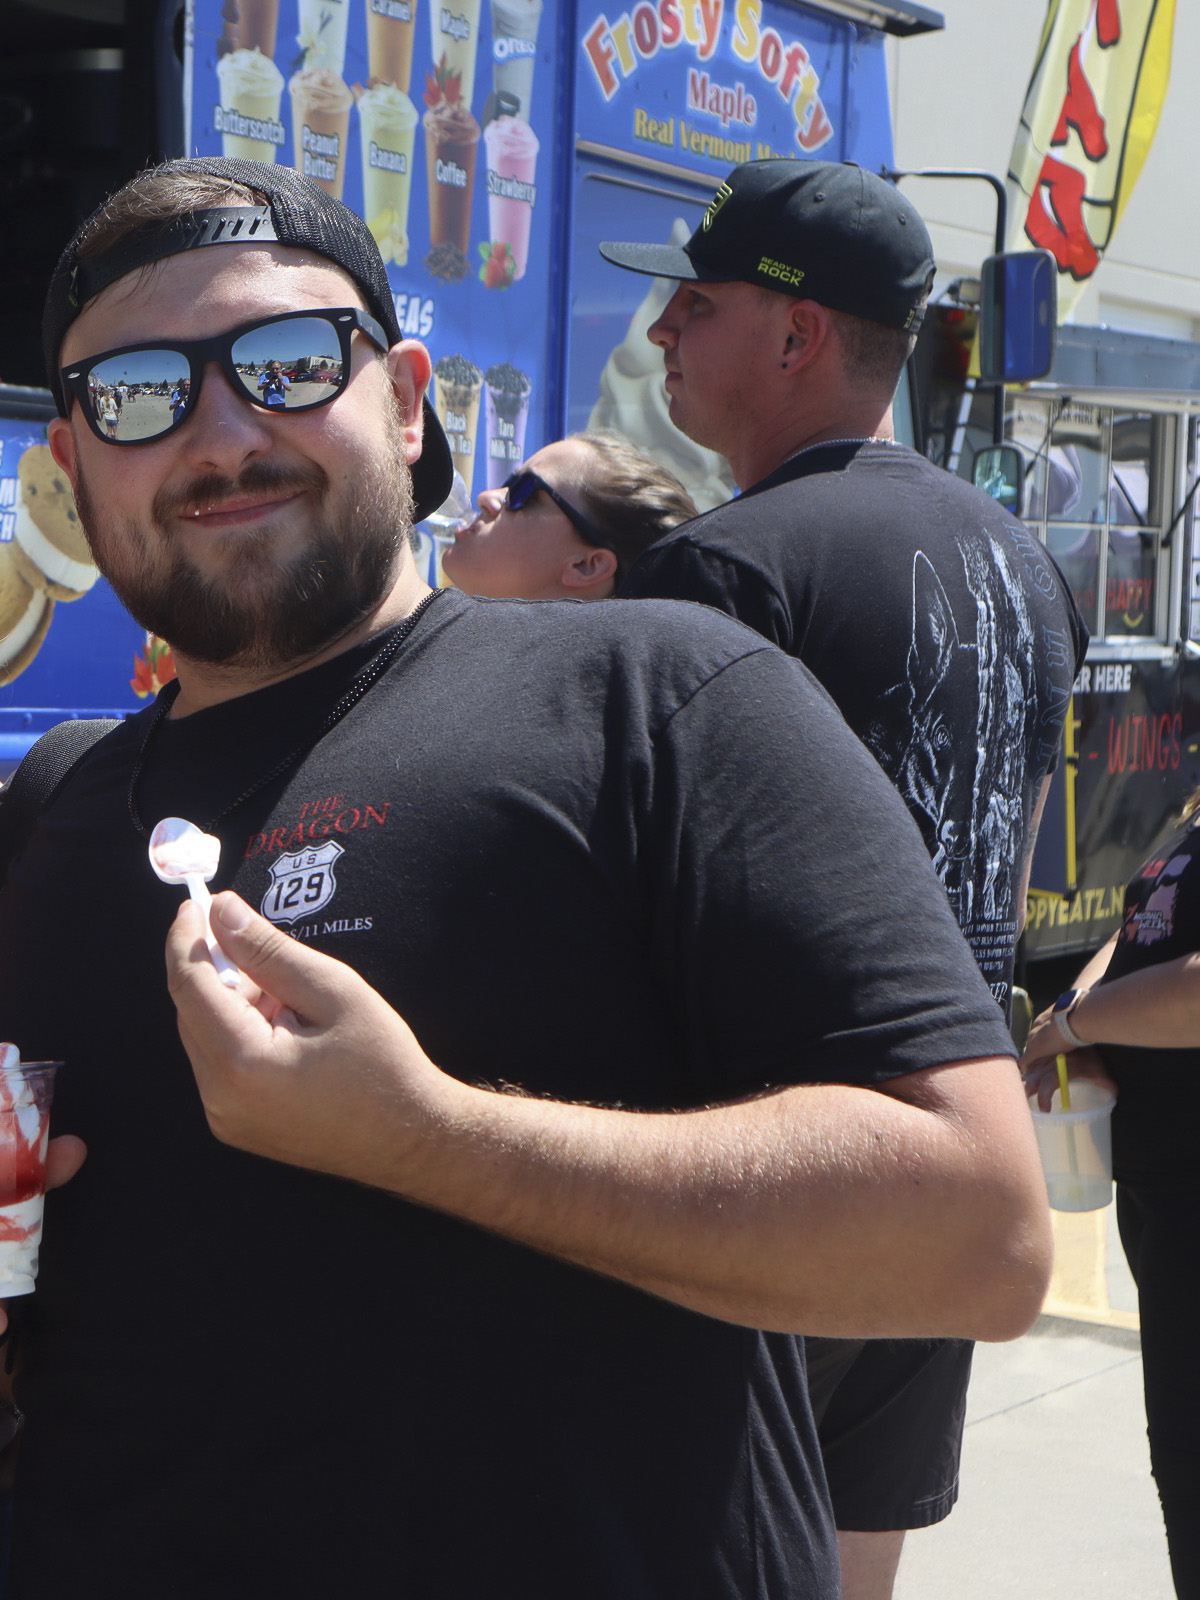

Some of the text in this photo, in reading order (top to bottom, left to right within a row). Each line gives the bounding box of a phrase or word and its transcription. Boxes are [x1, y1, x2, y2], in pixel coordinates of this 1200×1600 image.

[584, 0, 834, 152] Frosty Softy
[688, 67, 757, 128] Maple
[215, 106, 285, 145] Butterscotch
[303, 125, 339, 157] Peanut
[635, 108, 674, 146] Real
[680, 119, 751, 163] Vermont
[304, 155, 336, 181] Butter
[369, 143, 407, 174] Banana
[436, 159, 467, 187] Coffee
[487, 174, 536, 206] Strawberry
[757, 262, 802, 287] ROCK
[761, 256, 805, 278] READY TO
[393, 293, 434, 336] EAS
[1094, 663, 1132, 693] HERE
[1108, 712, 1182, 775] WINGS
[300, 794, 344, 819] THE
[243, 802, 390, 858] DRAGON
[292, 854, 317, 869] US
[273, 872, 324, 912] 129
[322, 917, 373, 934] MILES
